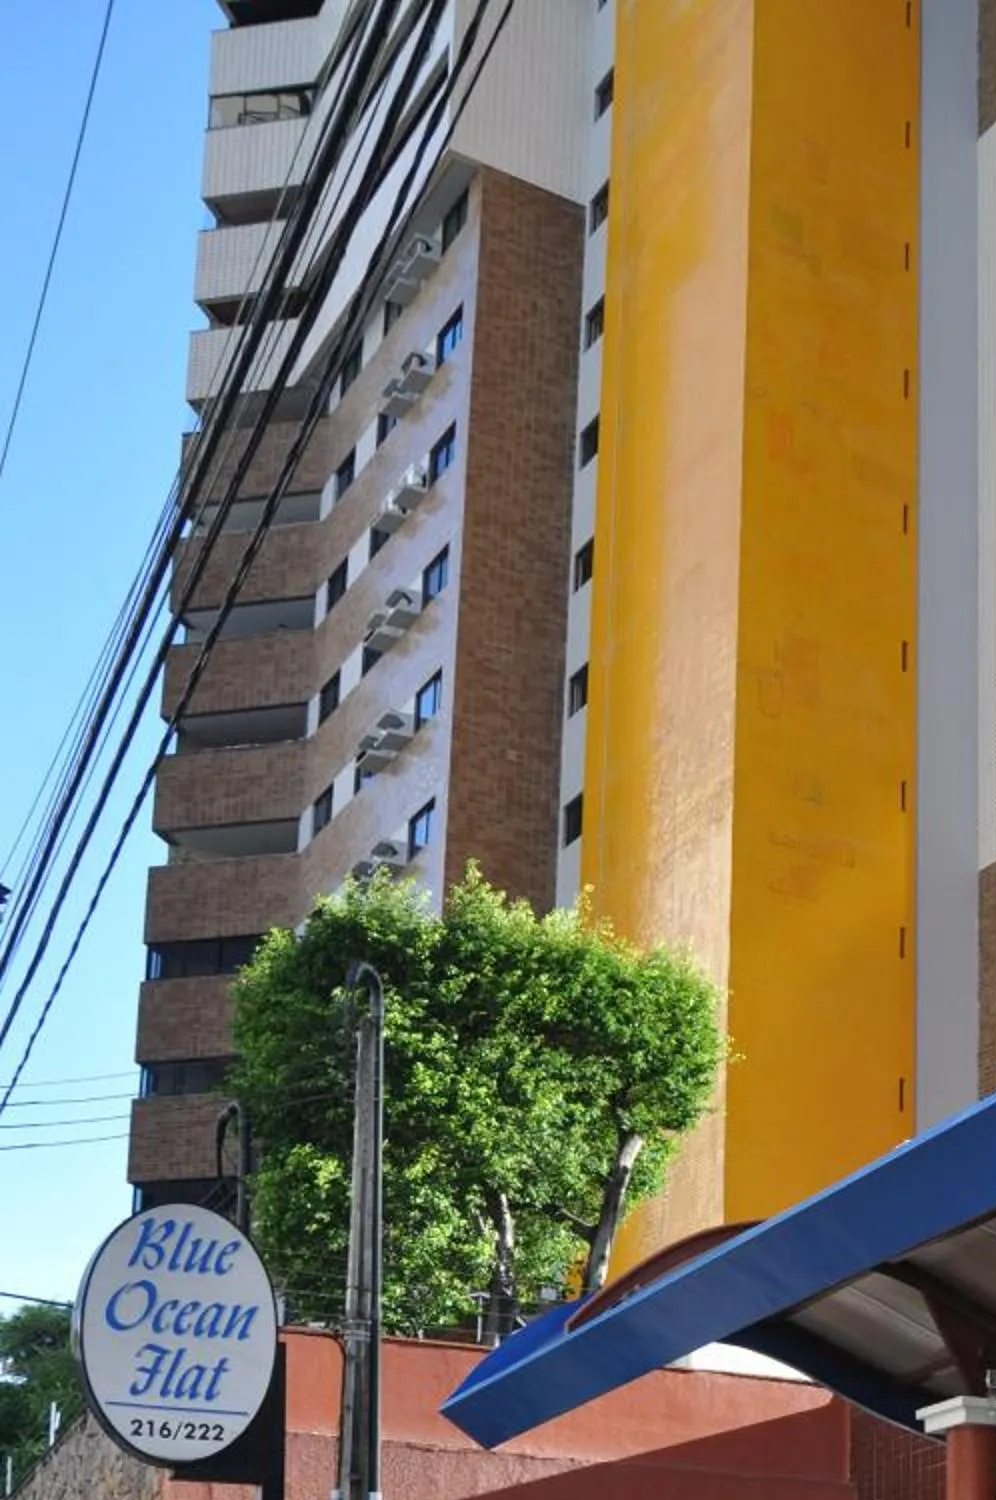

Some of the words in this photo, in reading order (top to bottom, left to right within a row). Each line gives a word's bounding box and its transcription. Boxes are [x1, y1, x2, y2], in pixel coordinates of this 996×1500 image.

[128, 1218, 241, 1276] Blue
[105, 1279, 259, 1341] Ocean
[129, 1343, 231, 1402] Flat
[130, 1419, 225, 1442] 216/222
